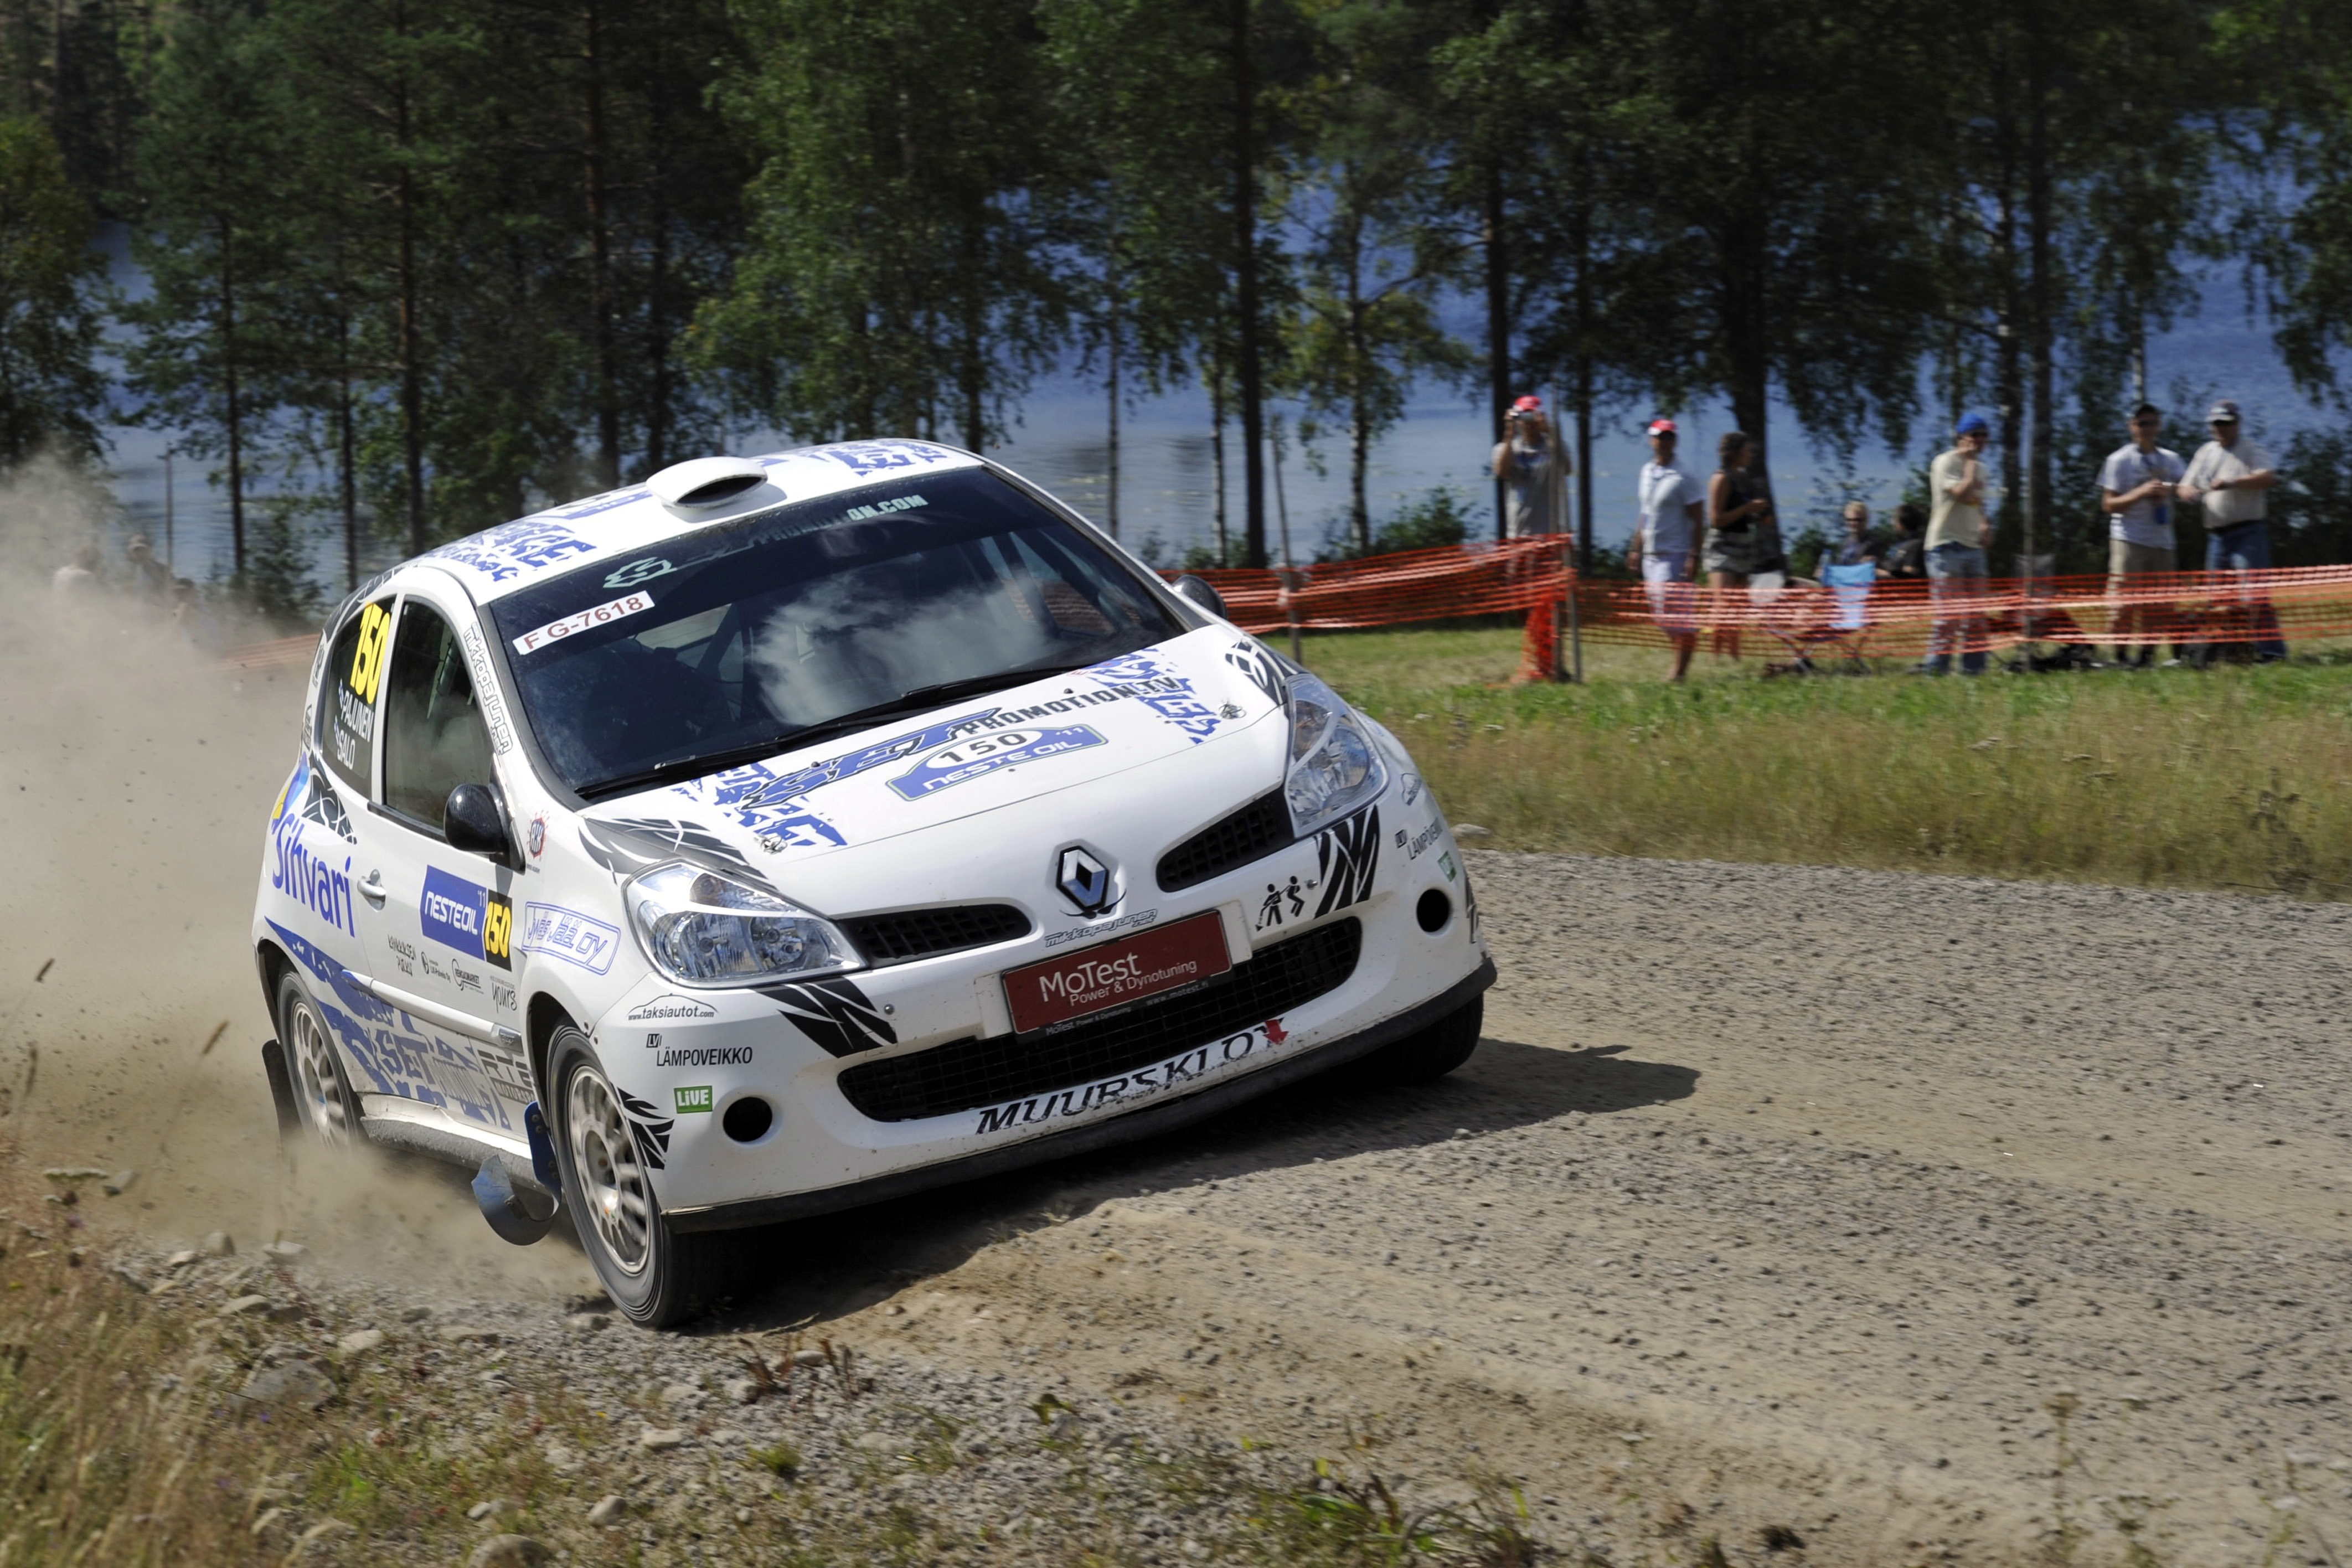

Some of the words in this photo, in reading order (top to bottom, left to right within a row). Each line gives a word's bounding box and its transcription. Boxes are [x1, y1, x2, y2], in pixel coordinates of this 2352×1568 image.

[523, 632, 539, 650] F
[546, 597, 644, 638] G-7618
[349, 601, 390, 705] 150
[341, 690, 374, 742] PAJUNEN
[337, 729, 356, 770] SALO
[938, 729, 1028, 763] 150
[272, 813, 355, 938] Sihvari
[484, 901, 512, 958] 150
[1039, 951, 1142, 1002] MoTest
[1069, 986, 1110, 1007] Power
[1113, 980, 1125, 993] &
[1126, 960, 1198, 991] Dynotuning
[628, 1005, 715, 1020] www.taksiautot.com
